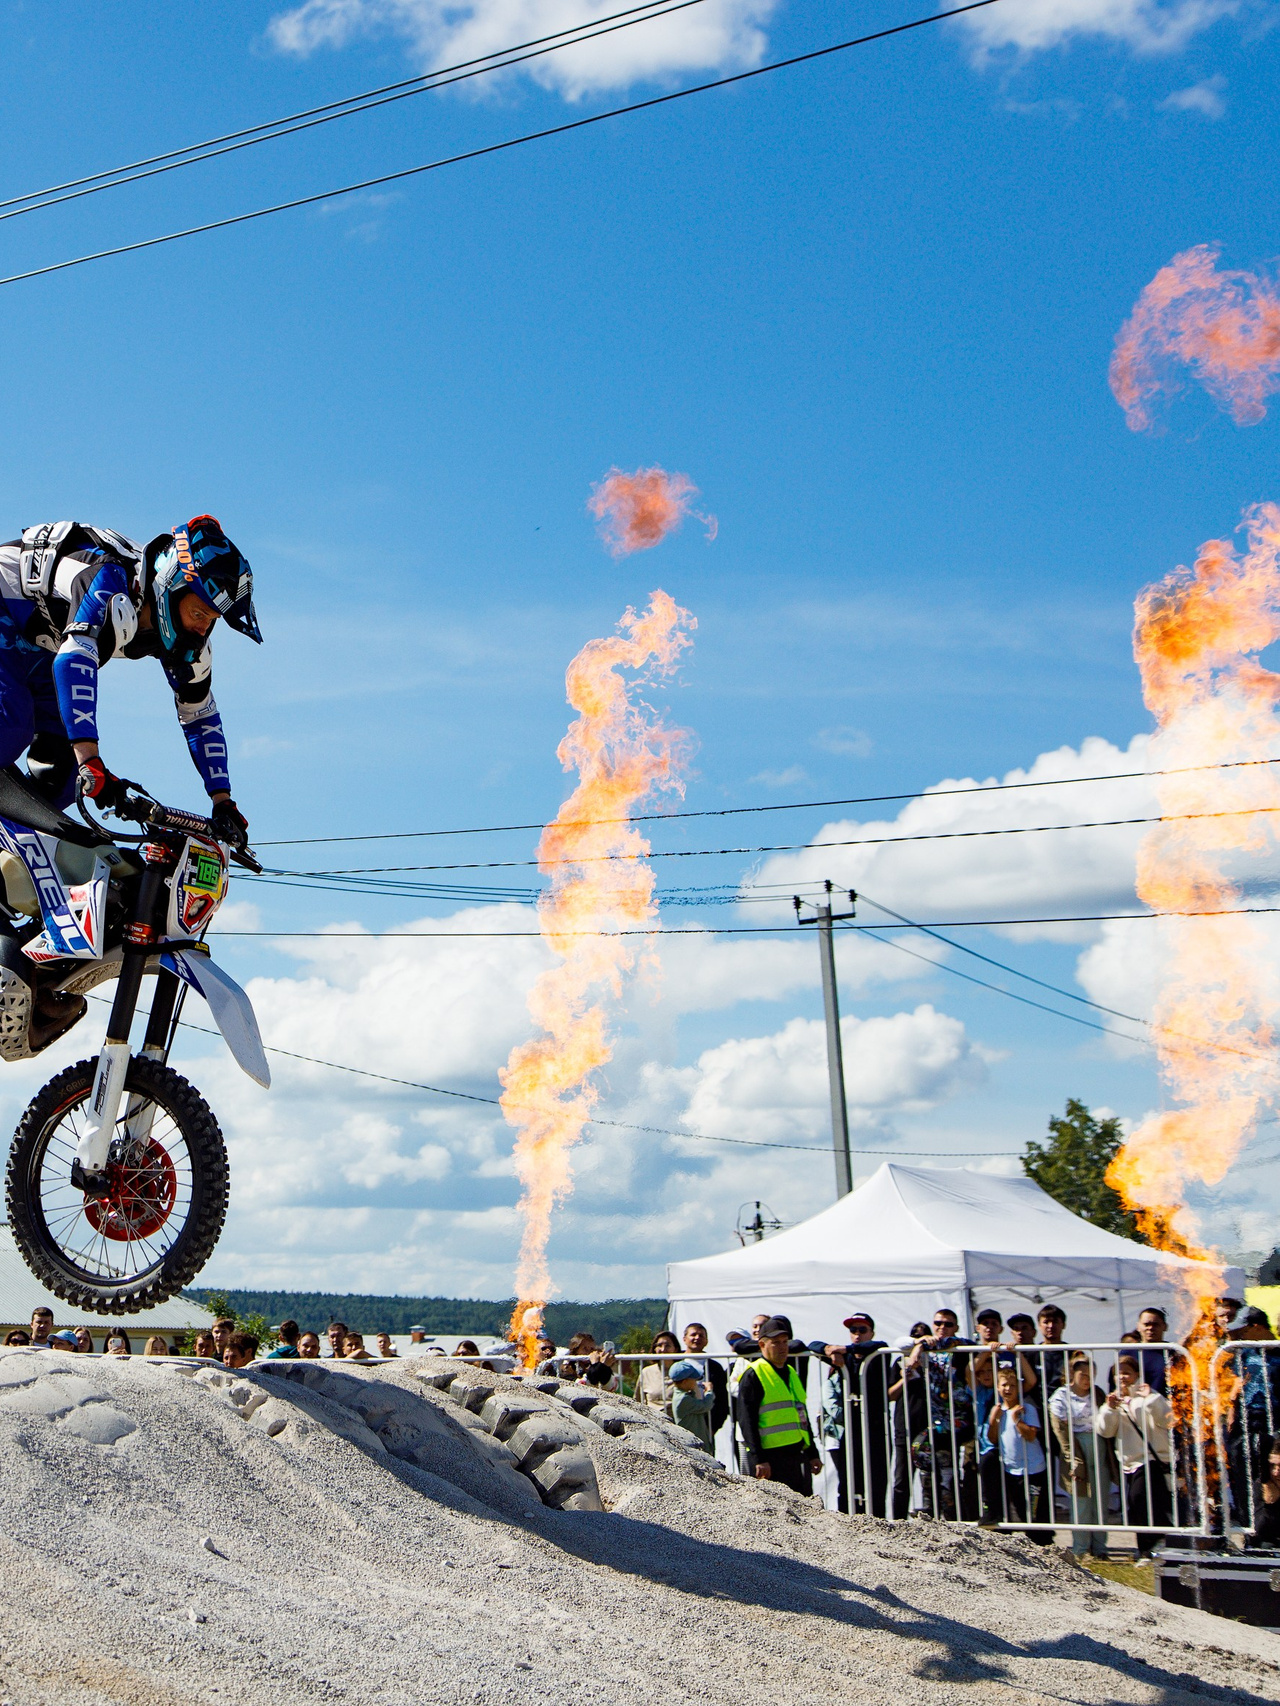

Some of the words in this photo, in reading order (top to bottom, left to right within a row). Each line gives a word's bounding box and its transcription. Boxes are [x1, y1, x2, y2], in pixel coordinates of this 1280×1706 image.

[175, 530, 199, 583] 100%
[70, 662, 95, 726] FOX
[201, 723, 228, 779] FOX
[166, 815, 207, 831] RENTHAL
[14, 832, 97, 957] RIEJU
[198, 862, 220, 885] 185
